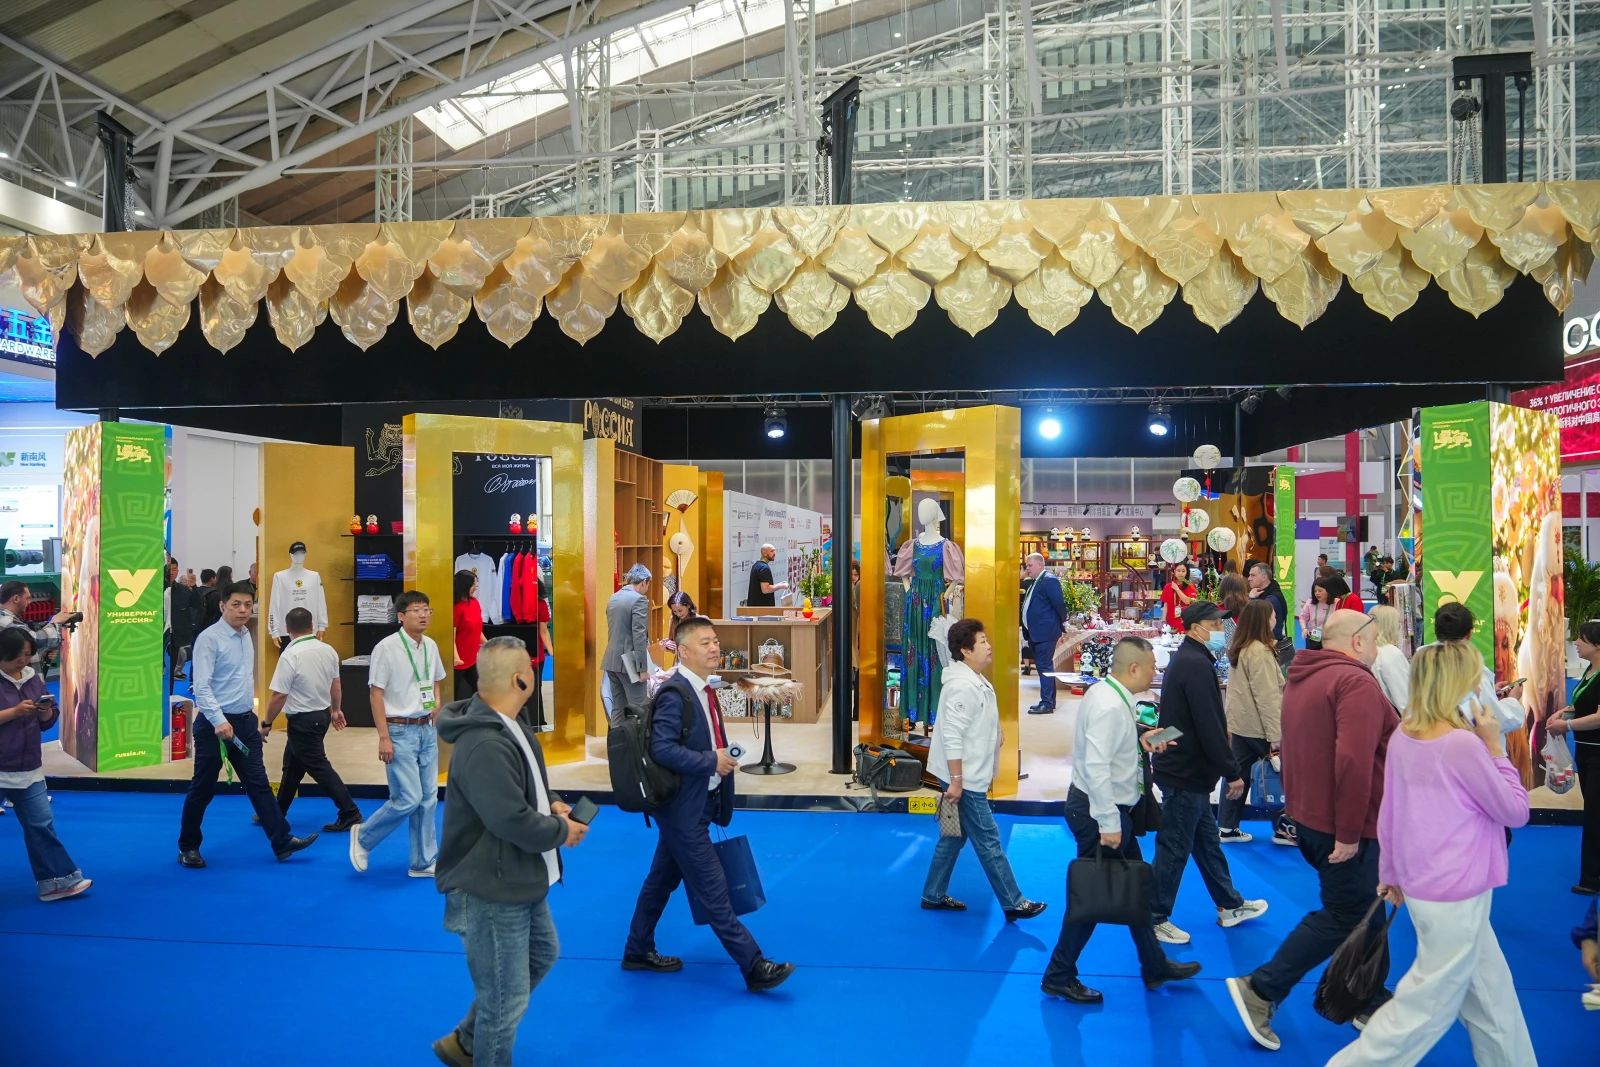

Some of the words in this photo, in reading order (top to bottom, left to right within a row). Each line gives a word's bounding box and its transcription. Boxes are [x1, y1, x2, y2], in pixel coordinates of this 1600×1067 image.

[0, 307, 53, 346] 五金
[0, 339, 56, 360] ARDWARE
[1529, 397, 1544, 408] 36%
[1549, 384, 1596, 404] УВЕЛИЧЕНИЕ
[1541, 399, 1597, 416] НОЛОГИЧНОГО
[20, 451, 47, 462] 新南风
[107, 610, 157, 618] УНИВЕРМАГ
[115, 750, 146, 758] russia.ru
